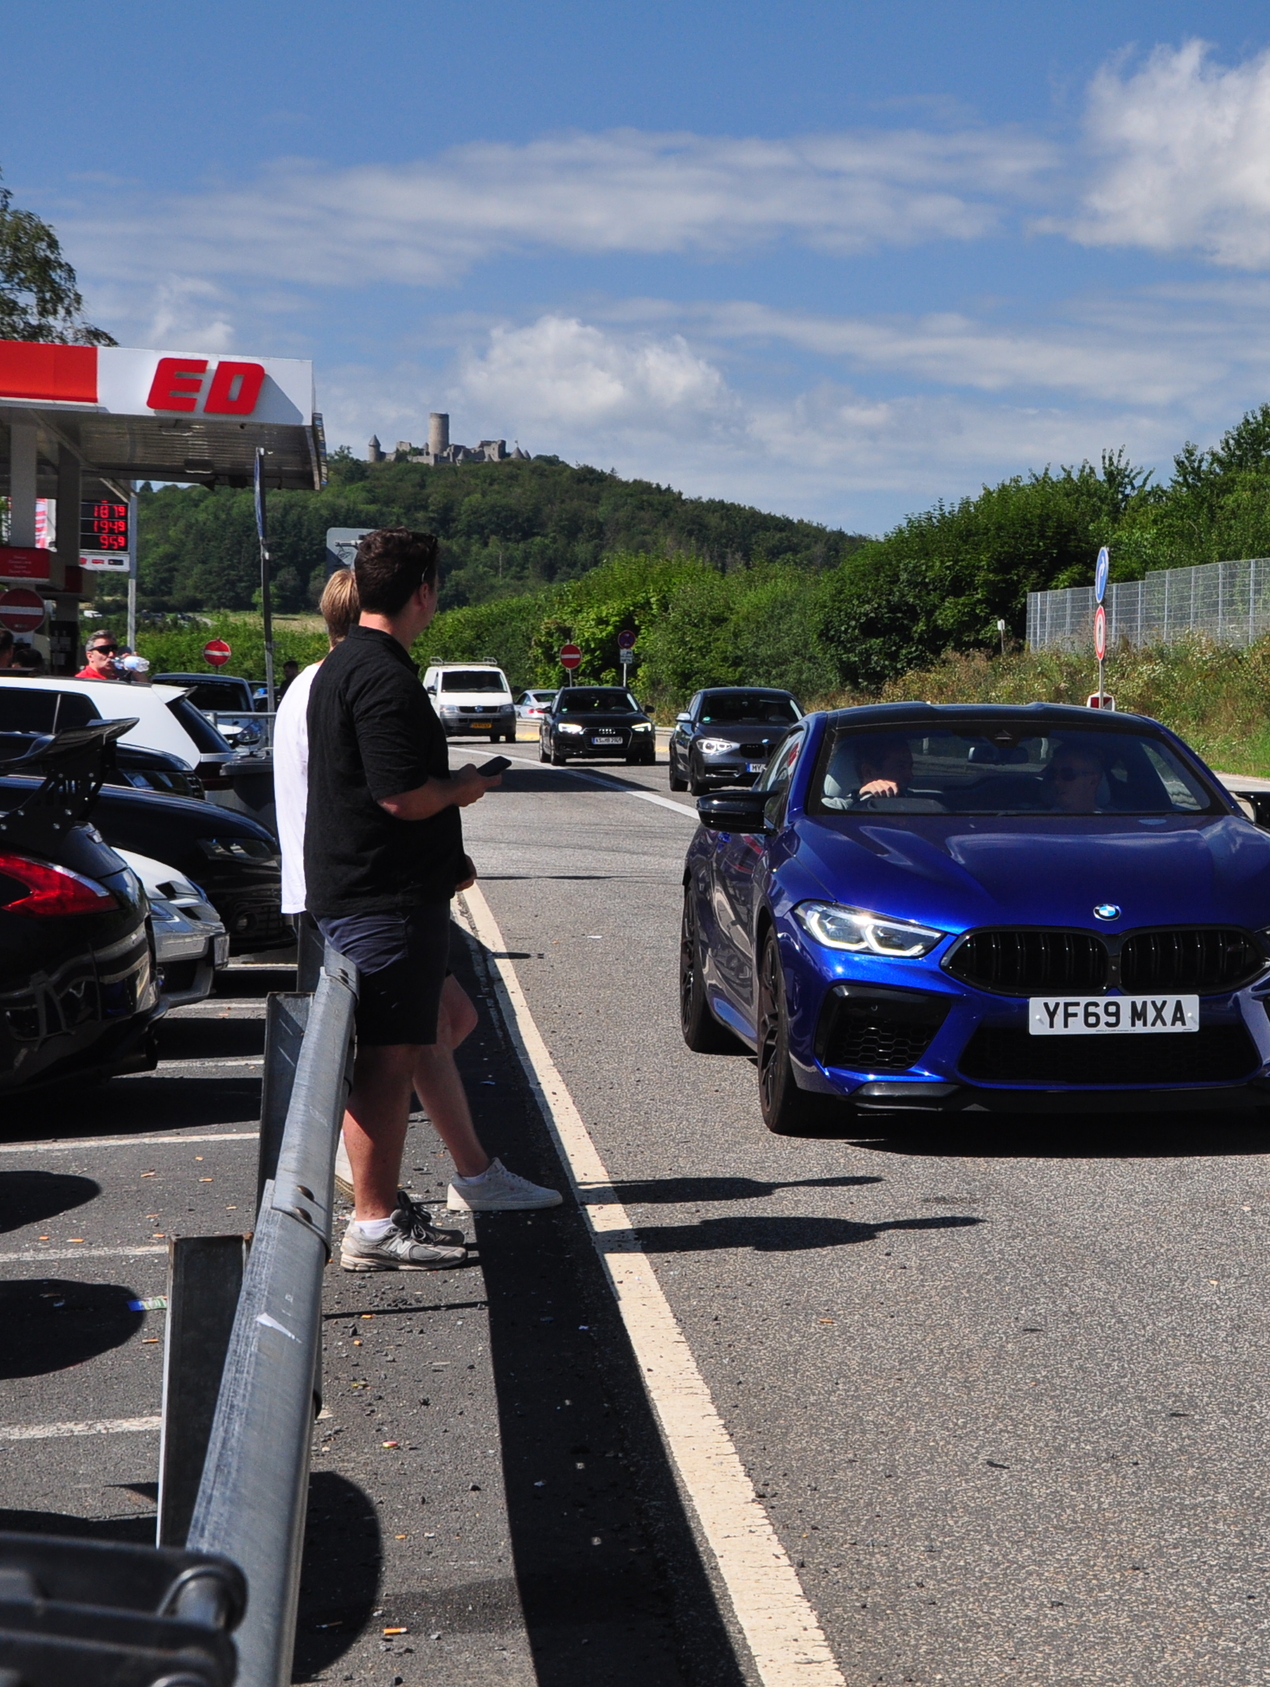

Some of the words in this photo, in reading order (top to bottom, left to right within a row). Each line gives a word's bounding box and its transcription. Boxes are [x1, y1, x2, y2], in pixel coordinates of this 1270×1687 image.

[146, 357, 265, 415] ED
[1042, 999, 1121, 1028] YF69
[1129, 999, 1188, 1027] MXA
